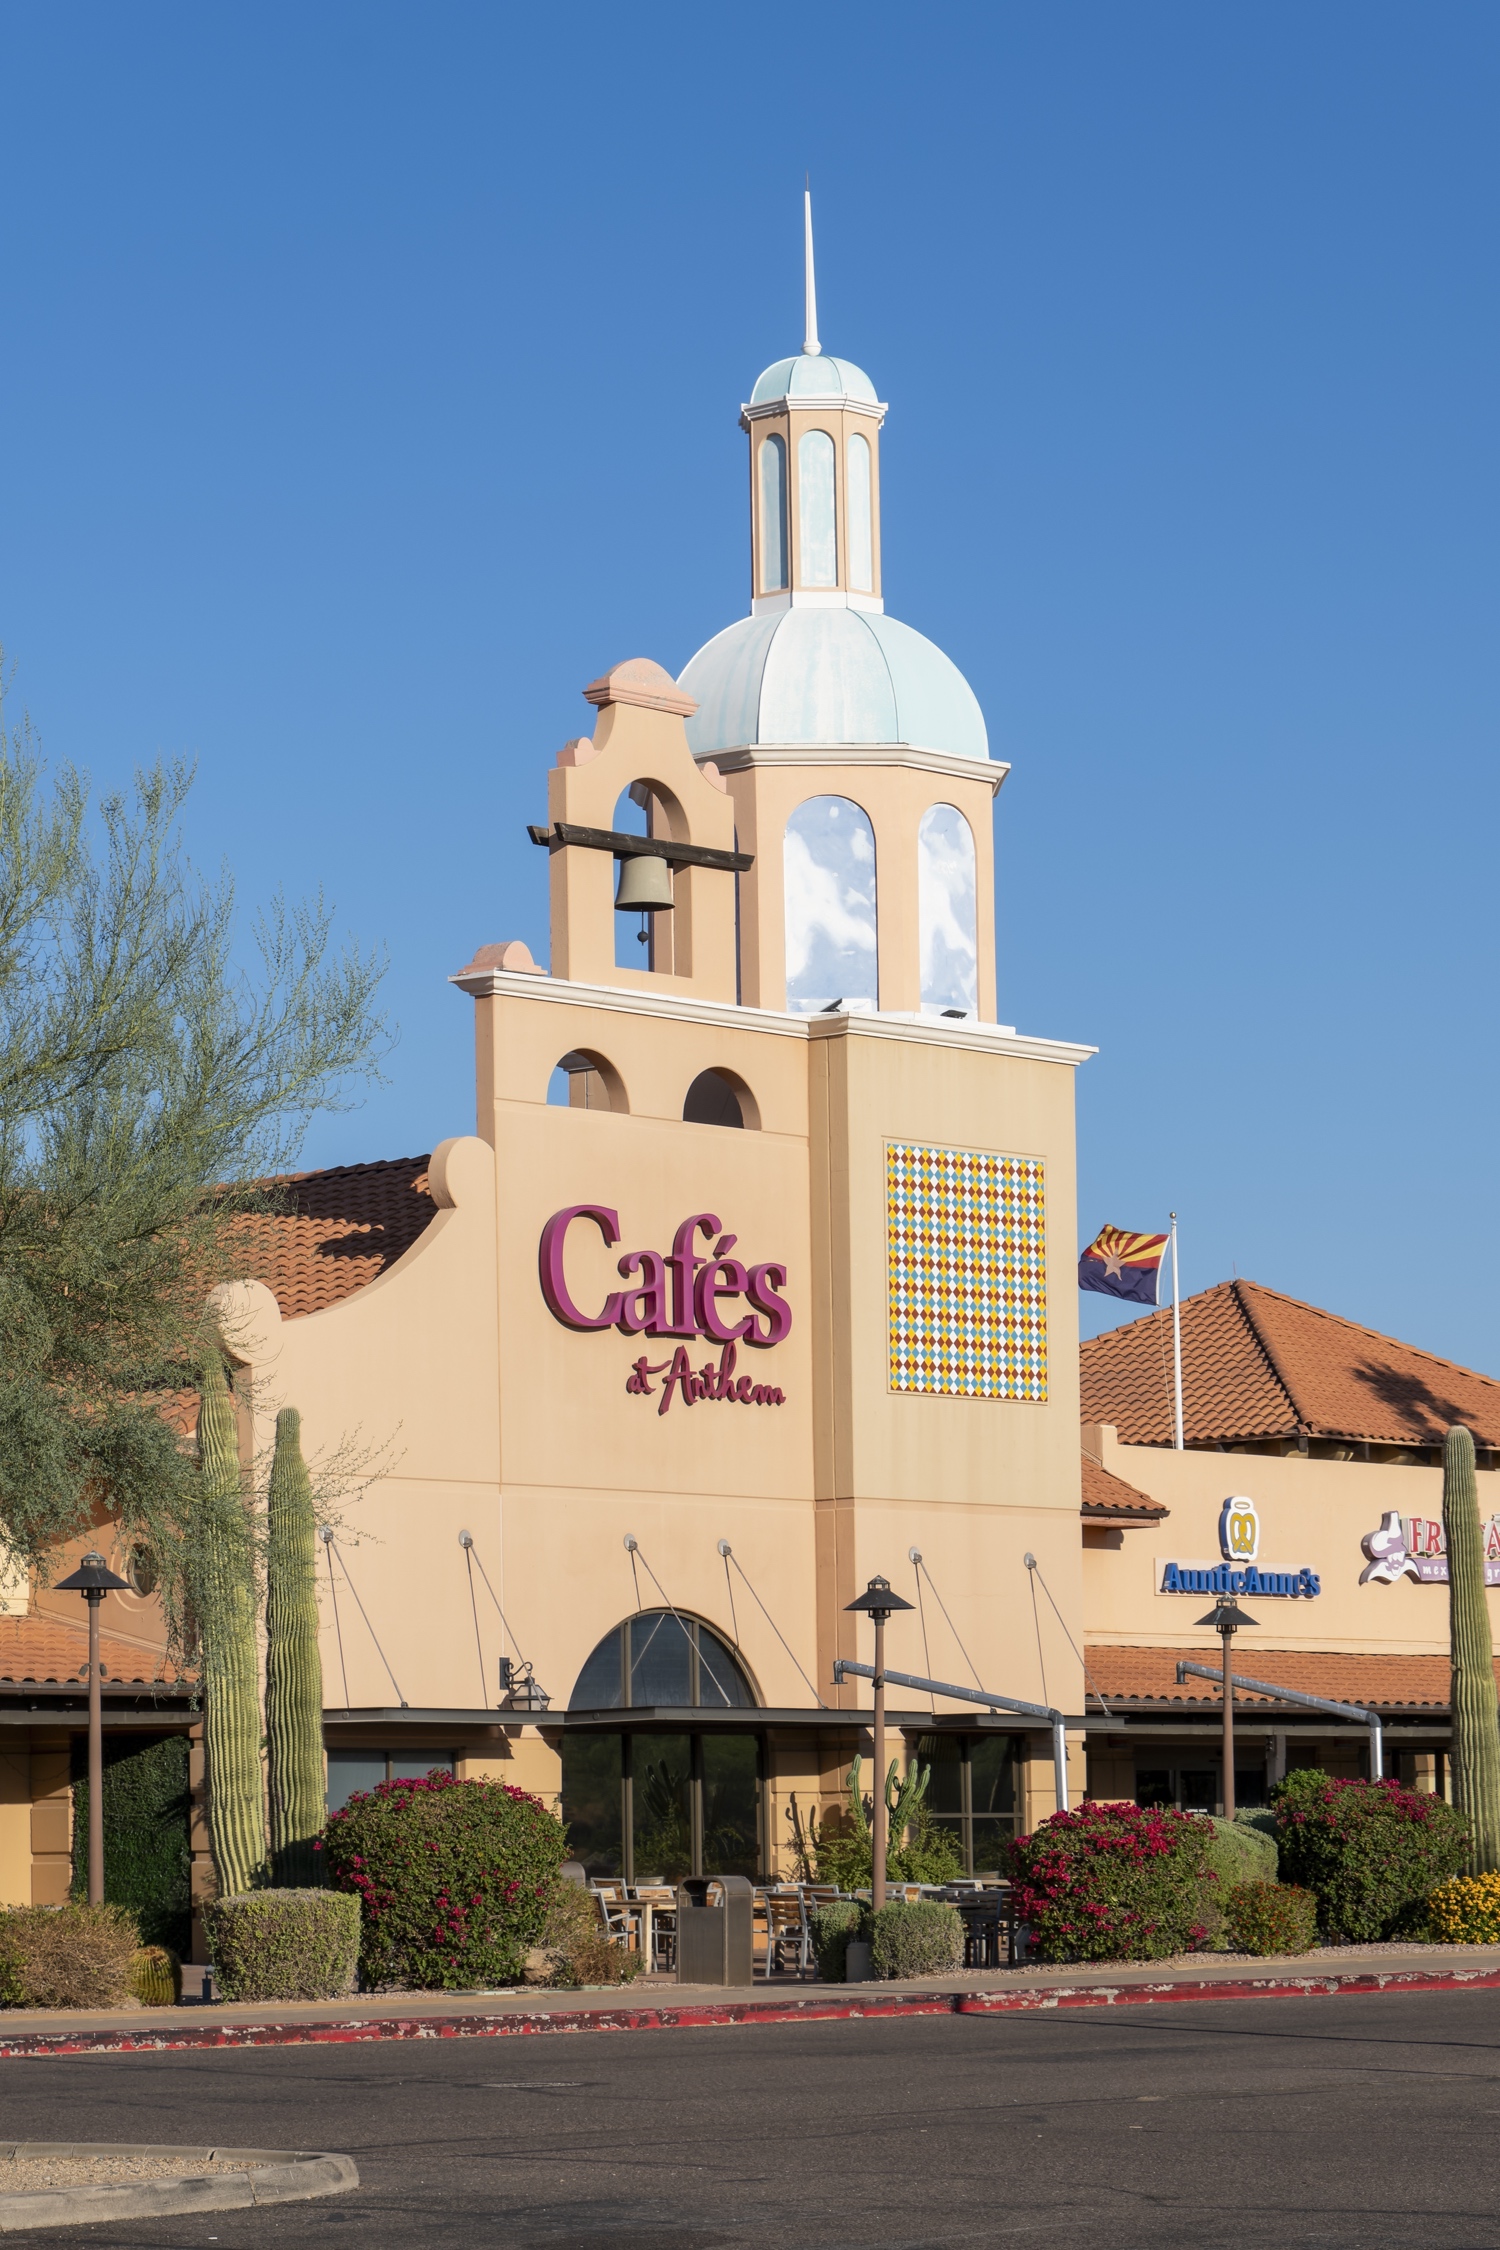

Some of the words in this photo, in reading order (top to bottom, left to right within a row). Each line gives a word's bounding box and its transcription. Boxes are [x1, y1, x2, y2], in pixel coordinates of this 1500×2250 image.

[539, 1204, 793, 1349] Cafés
[626, 1356, 672, 1395] at
[658, 1341, 786, 1416] Anthem
[1163, 1562, 1247, 1596] Auntie
[1245, 1566, 1321, 1599] Anne's
